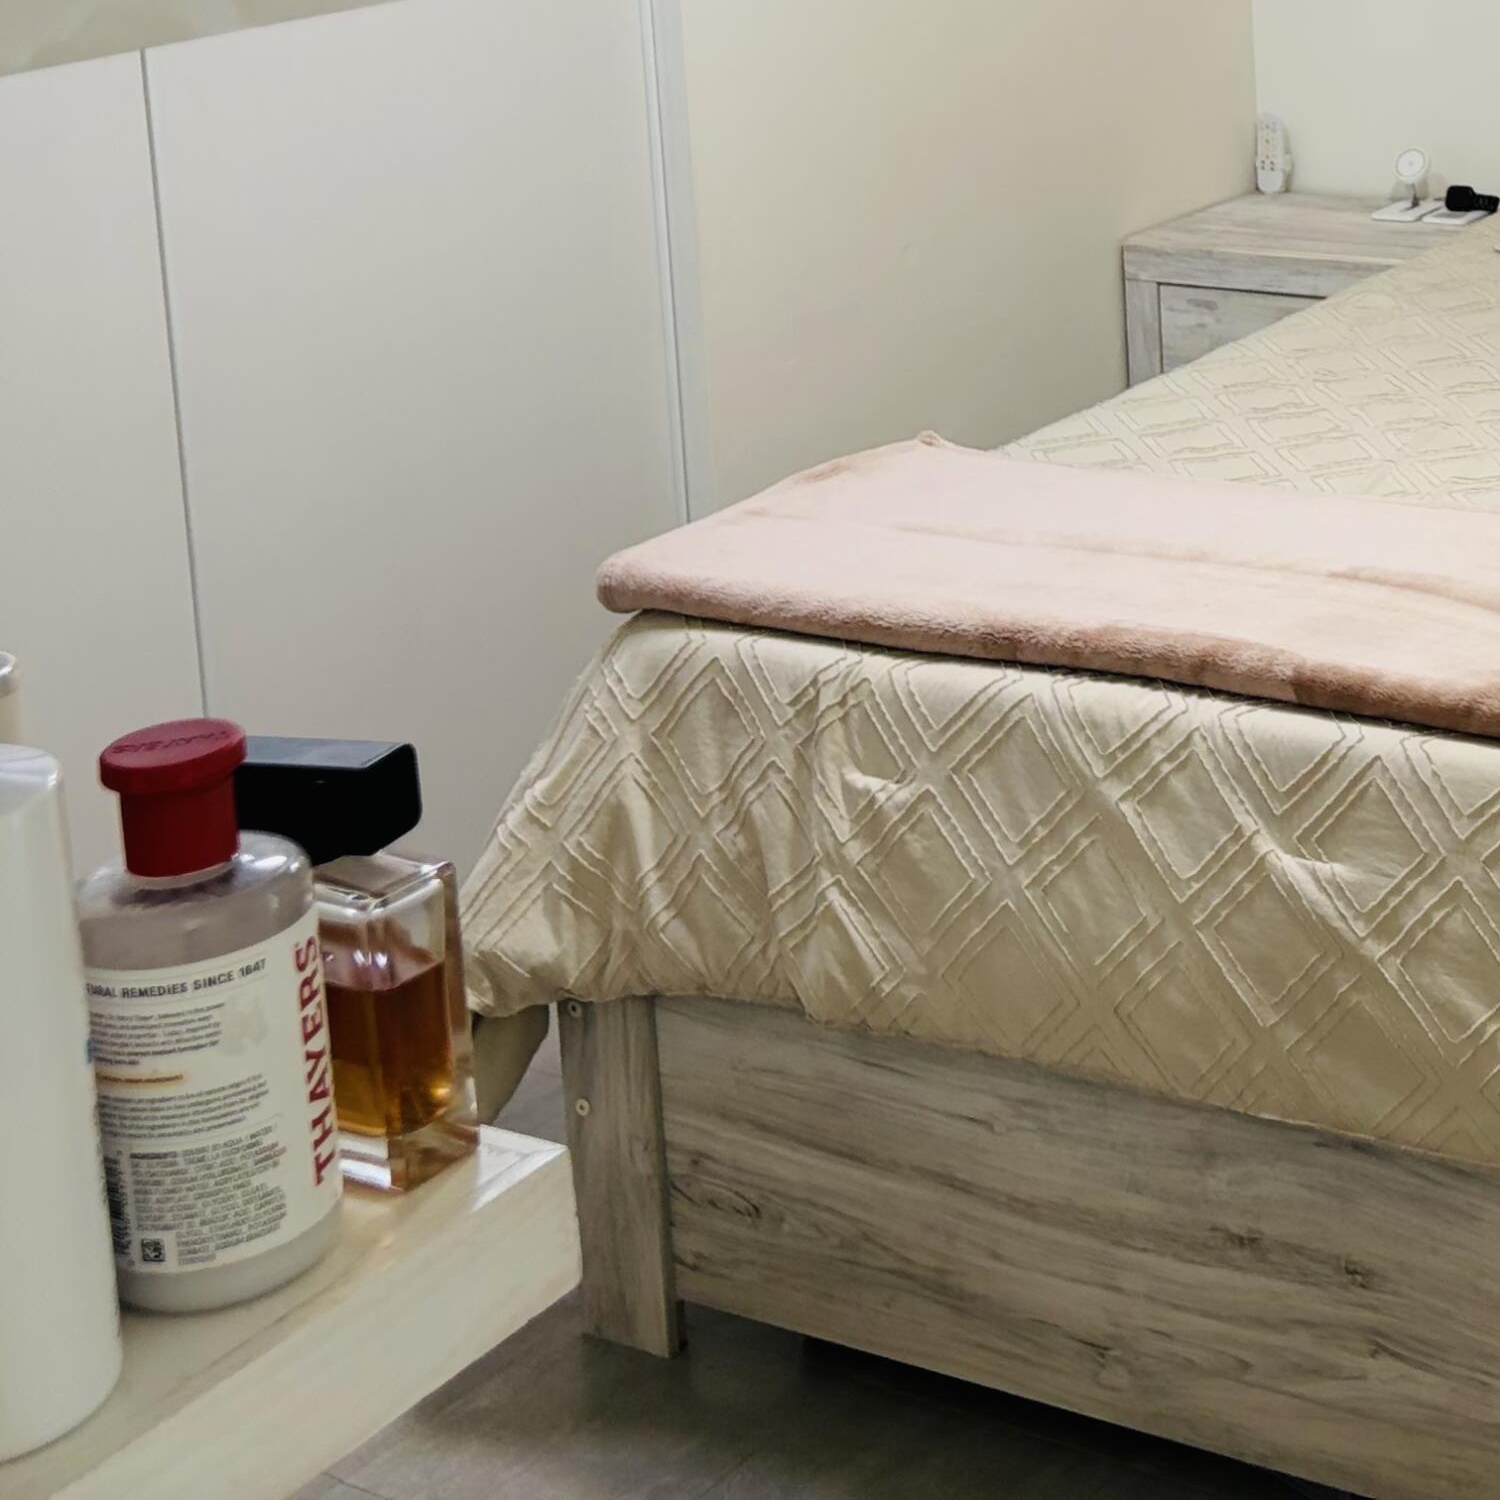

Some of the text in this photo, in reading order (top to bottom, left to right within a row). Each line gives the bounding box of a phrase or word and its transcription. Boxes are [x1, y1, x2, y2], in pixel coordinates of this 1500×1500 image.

[121, 981, 188, 999] REMEDIES
[193, 970, 235, 989] SINCE
[294, 934, 336, 1188] THAYERS
